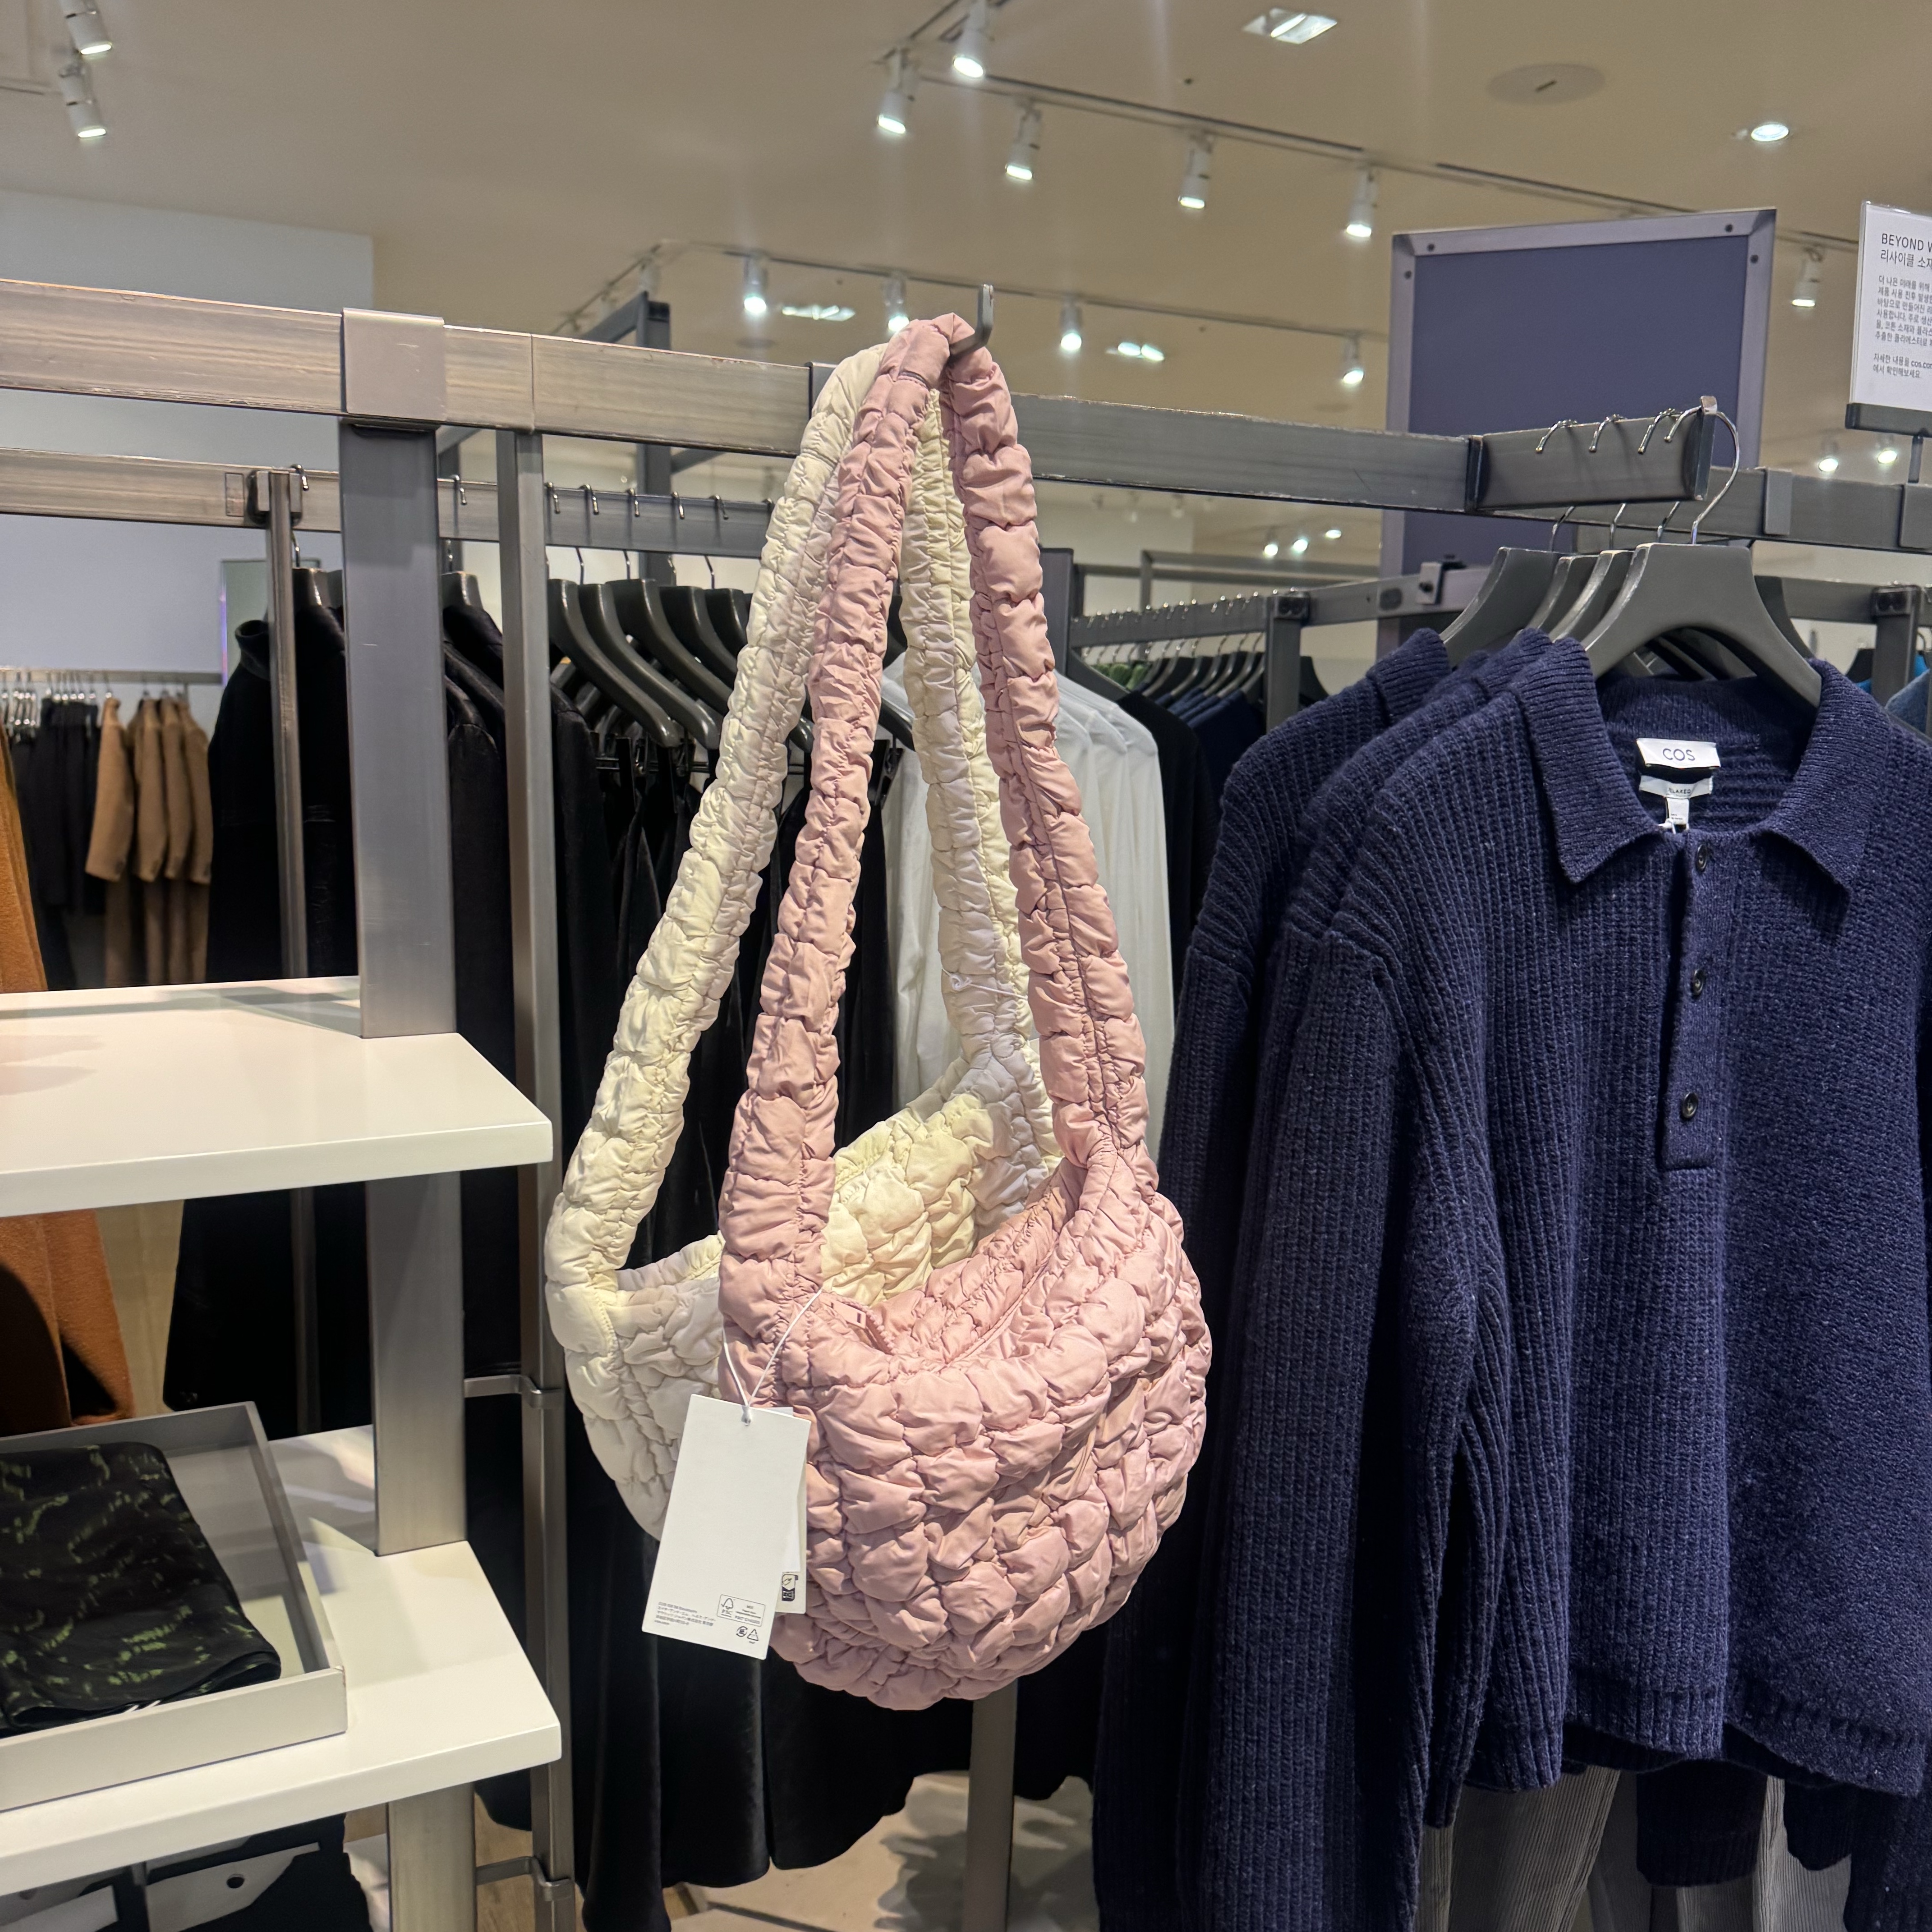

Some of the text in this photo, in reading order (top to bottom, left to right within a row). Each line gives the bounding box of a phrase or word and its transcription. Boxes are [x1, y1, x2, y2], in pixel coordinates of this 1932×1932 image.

[1881, 233, 1924, 251] BEYOND
[1881, 249, 1914, 267] 리사이클
[1879, 275, 1885, 285] 더
[1886, 276, 1898, 286] 나은
[1891, 289, 1903, 299] 사용
[1662, 748, 1695, 761] COS
